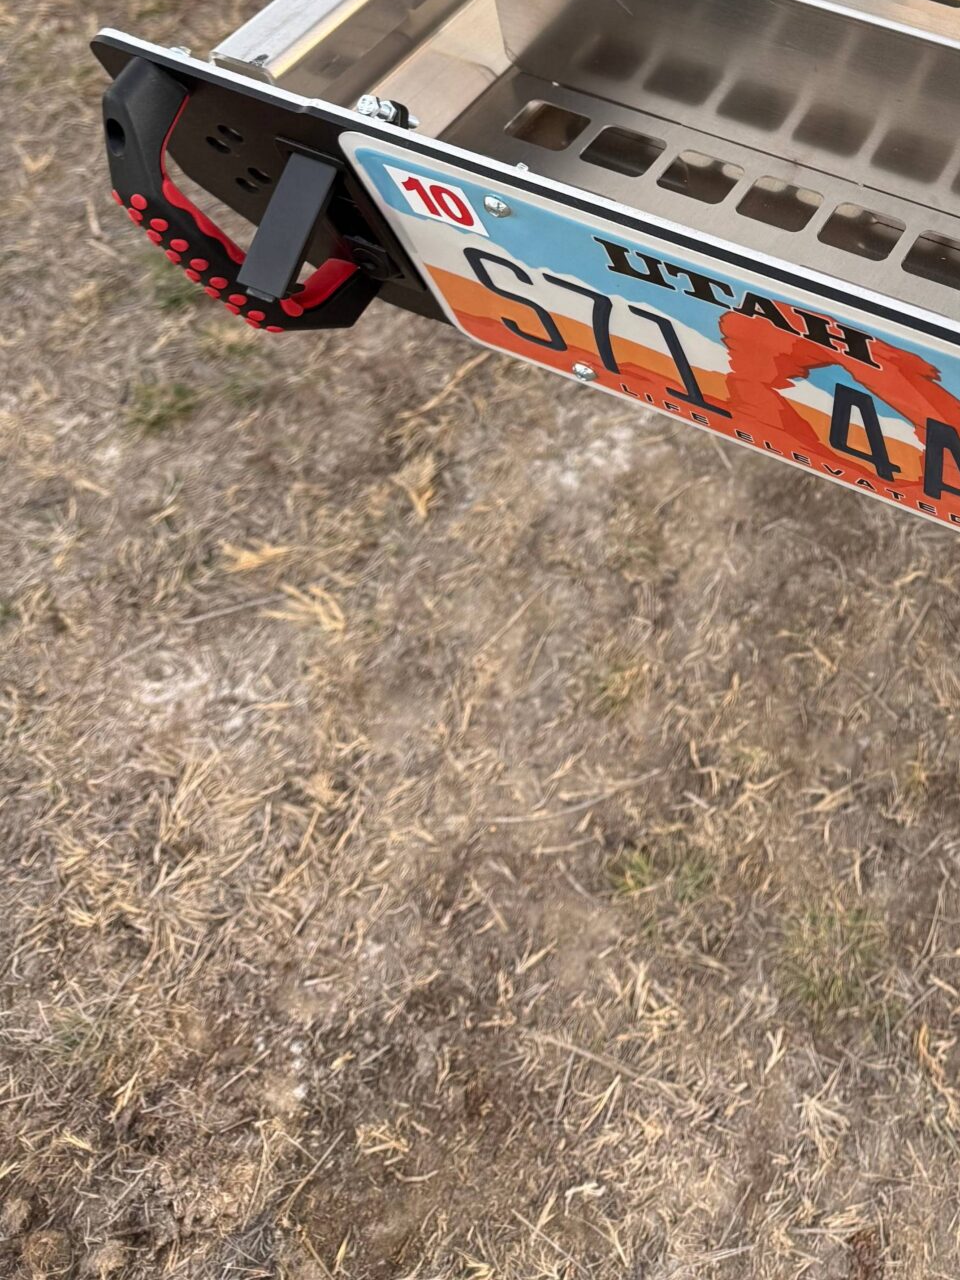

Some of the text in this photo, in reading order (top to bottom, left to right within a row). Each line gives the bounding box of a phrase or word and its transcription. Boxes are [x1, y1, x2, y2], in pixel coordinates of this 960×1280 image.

[401, 177, 475, 227] 10
[463, 247, 733, 419] S71
[592, 235, 883, 370] UTAH
[620, 383, 709, 426] LIFE
